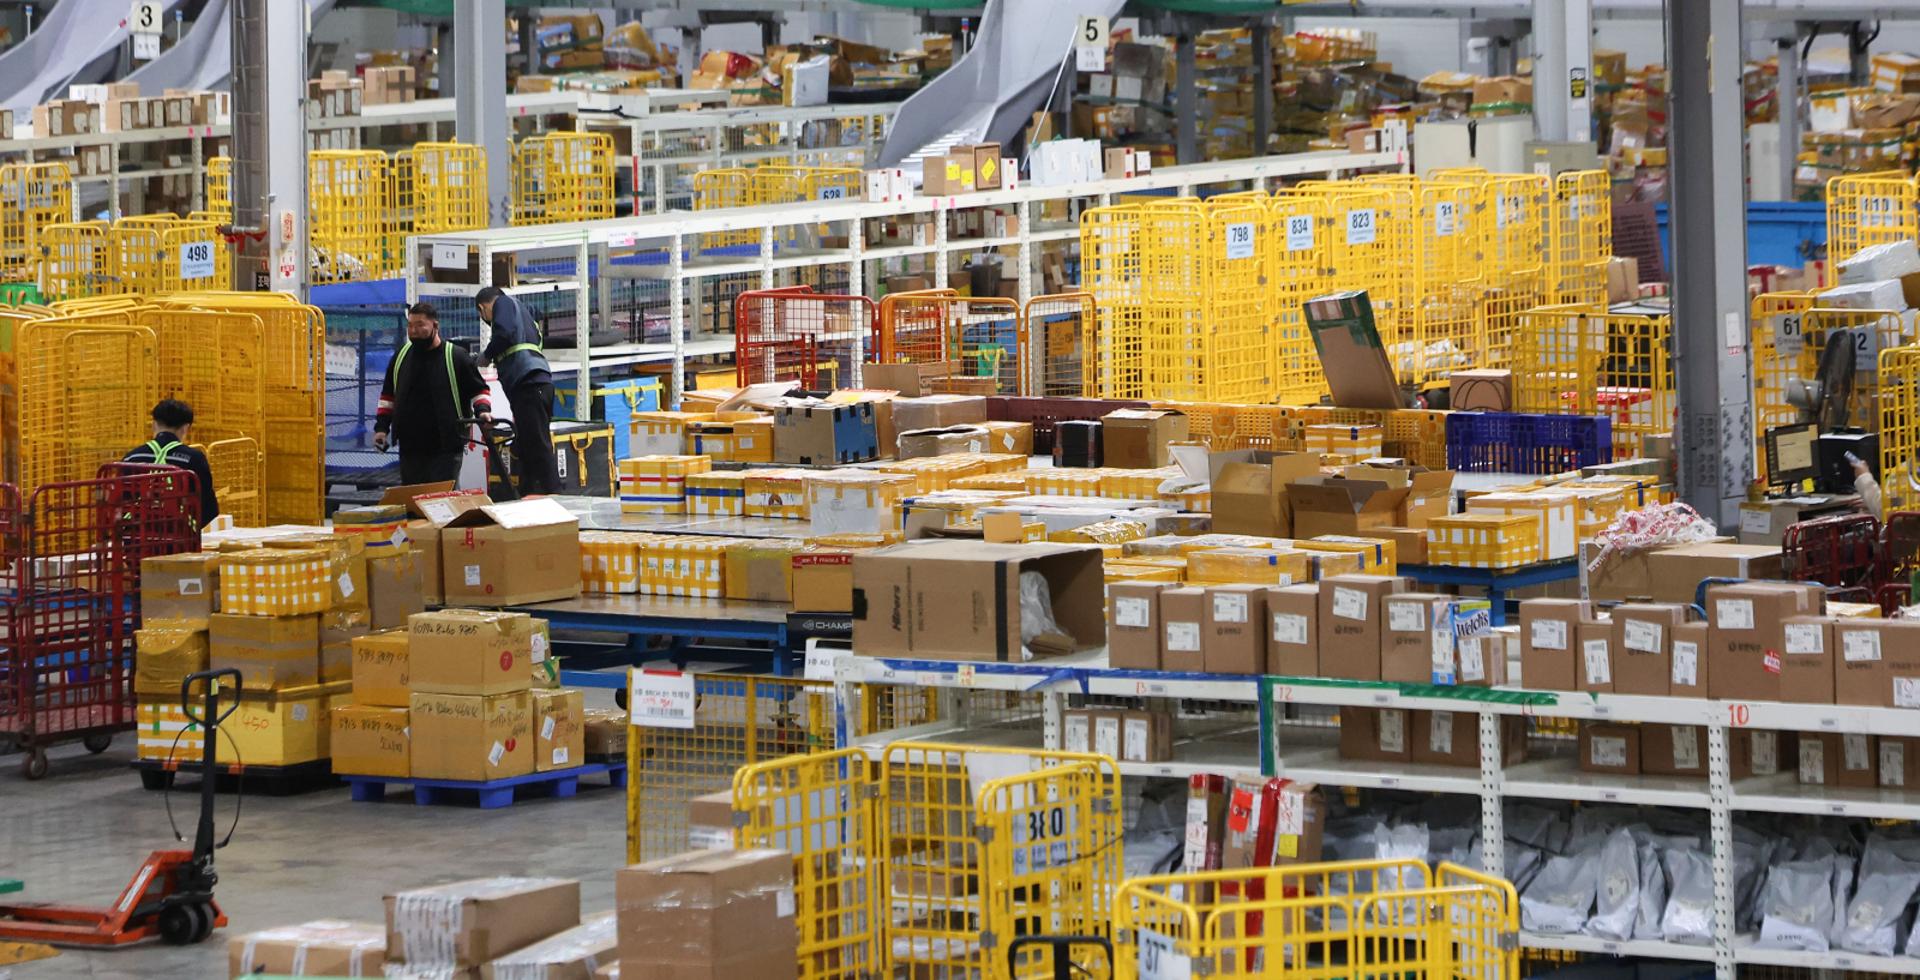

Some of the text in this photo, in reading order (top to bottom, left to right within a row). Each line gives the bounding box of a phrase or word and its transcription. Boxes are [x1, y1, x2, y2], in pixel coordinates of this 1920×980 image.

[141, 5, 152, 27] 3
[1085, 18, 1098, 41] 5
[1292, 219, 1308, 235] 834
[1352, 212, 1370, 228] 823
[1232, 226, 1249, 242] 798
[187, 245, 208, 262] 498
[1456, 611, 1489, 637] Welch's
[1727, 704, 1749, 727] 10
[1145, 938, 1167, 974] 37
